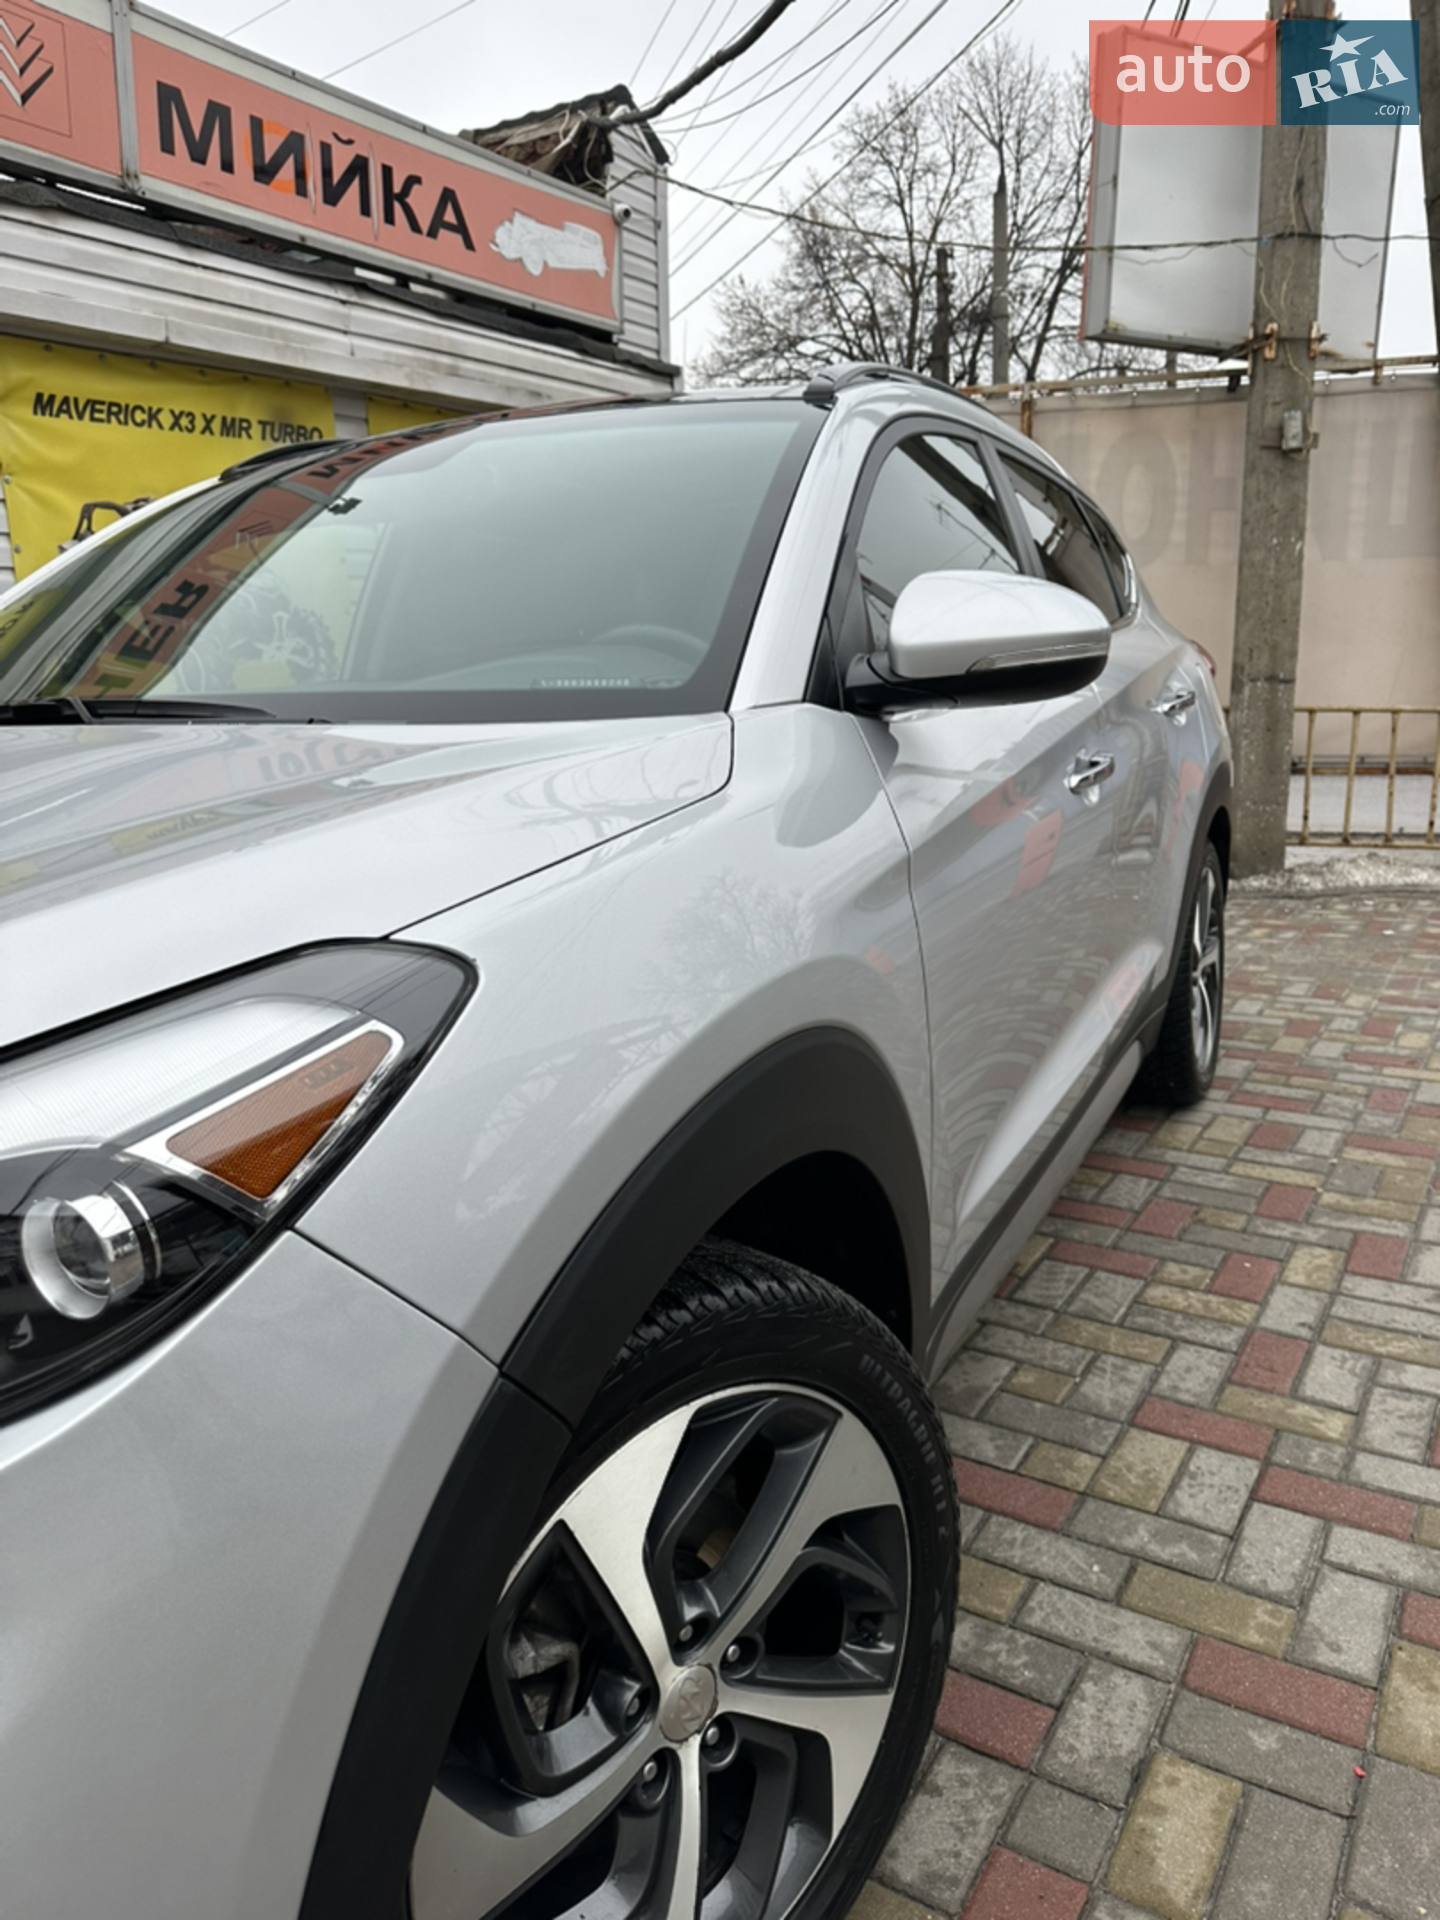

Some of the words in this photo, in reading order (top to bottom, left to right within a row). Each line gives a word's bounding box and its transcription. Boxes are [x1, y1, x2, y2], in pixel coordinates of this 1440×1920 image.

[156, 80, 476, 253] МИЙКА
[32, 392, 164, 431] MAVERICK
[168, 410, 196, 434] X3
[200, 413, 217, 436] X
[220, 416, 253, 440] MR
[258, 420, 324, 443] TURBO
